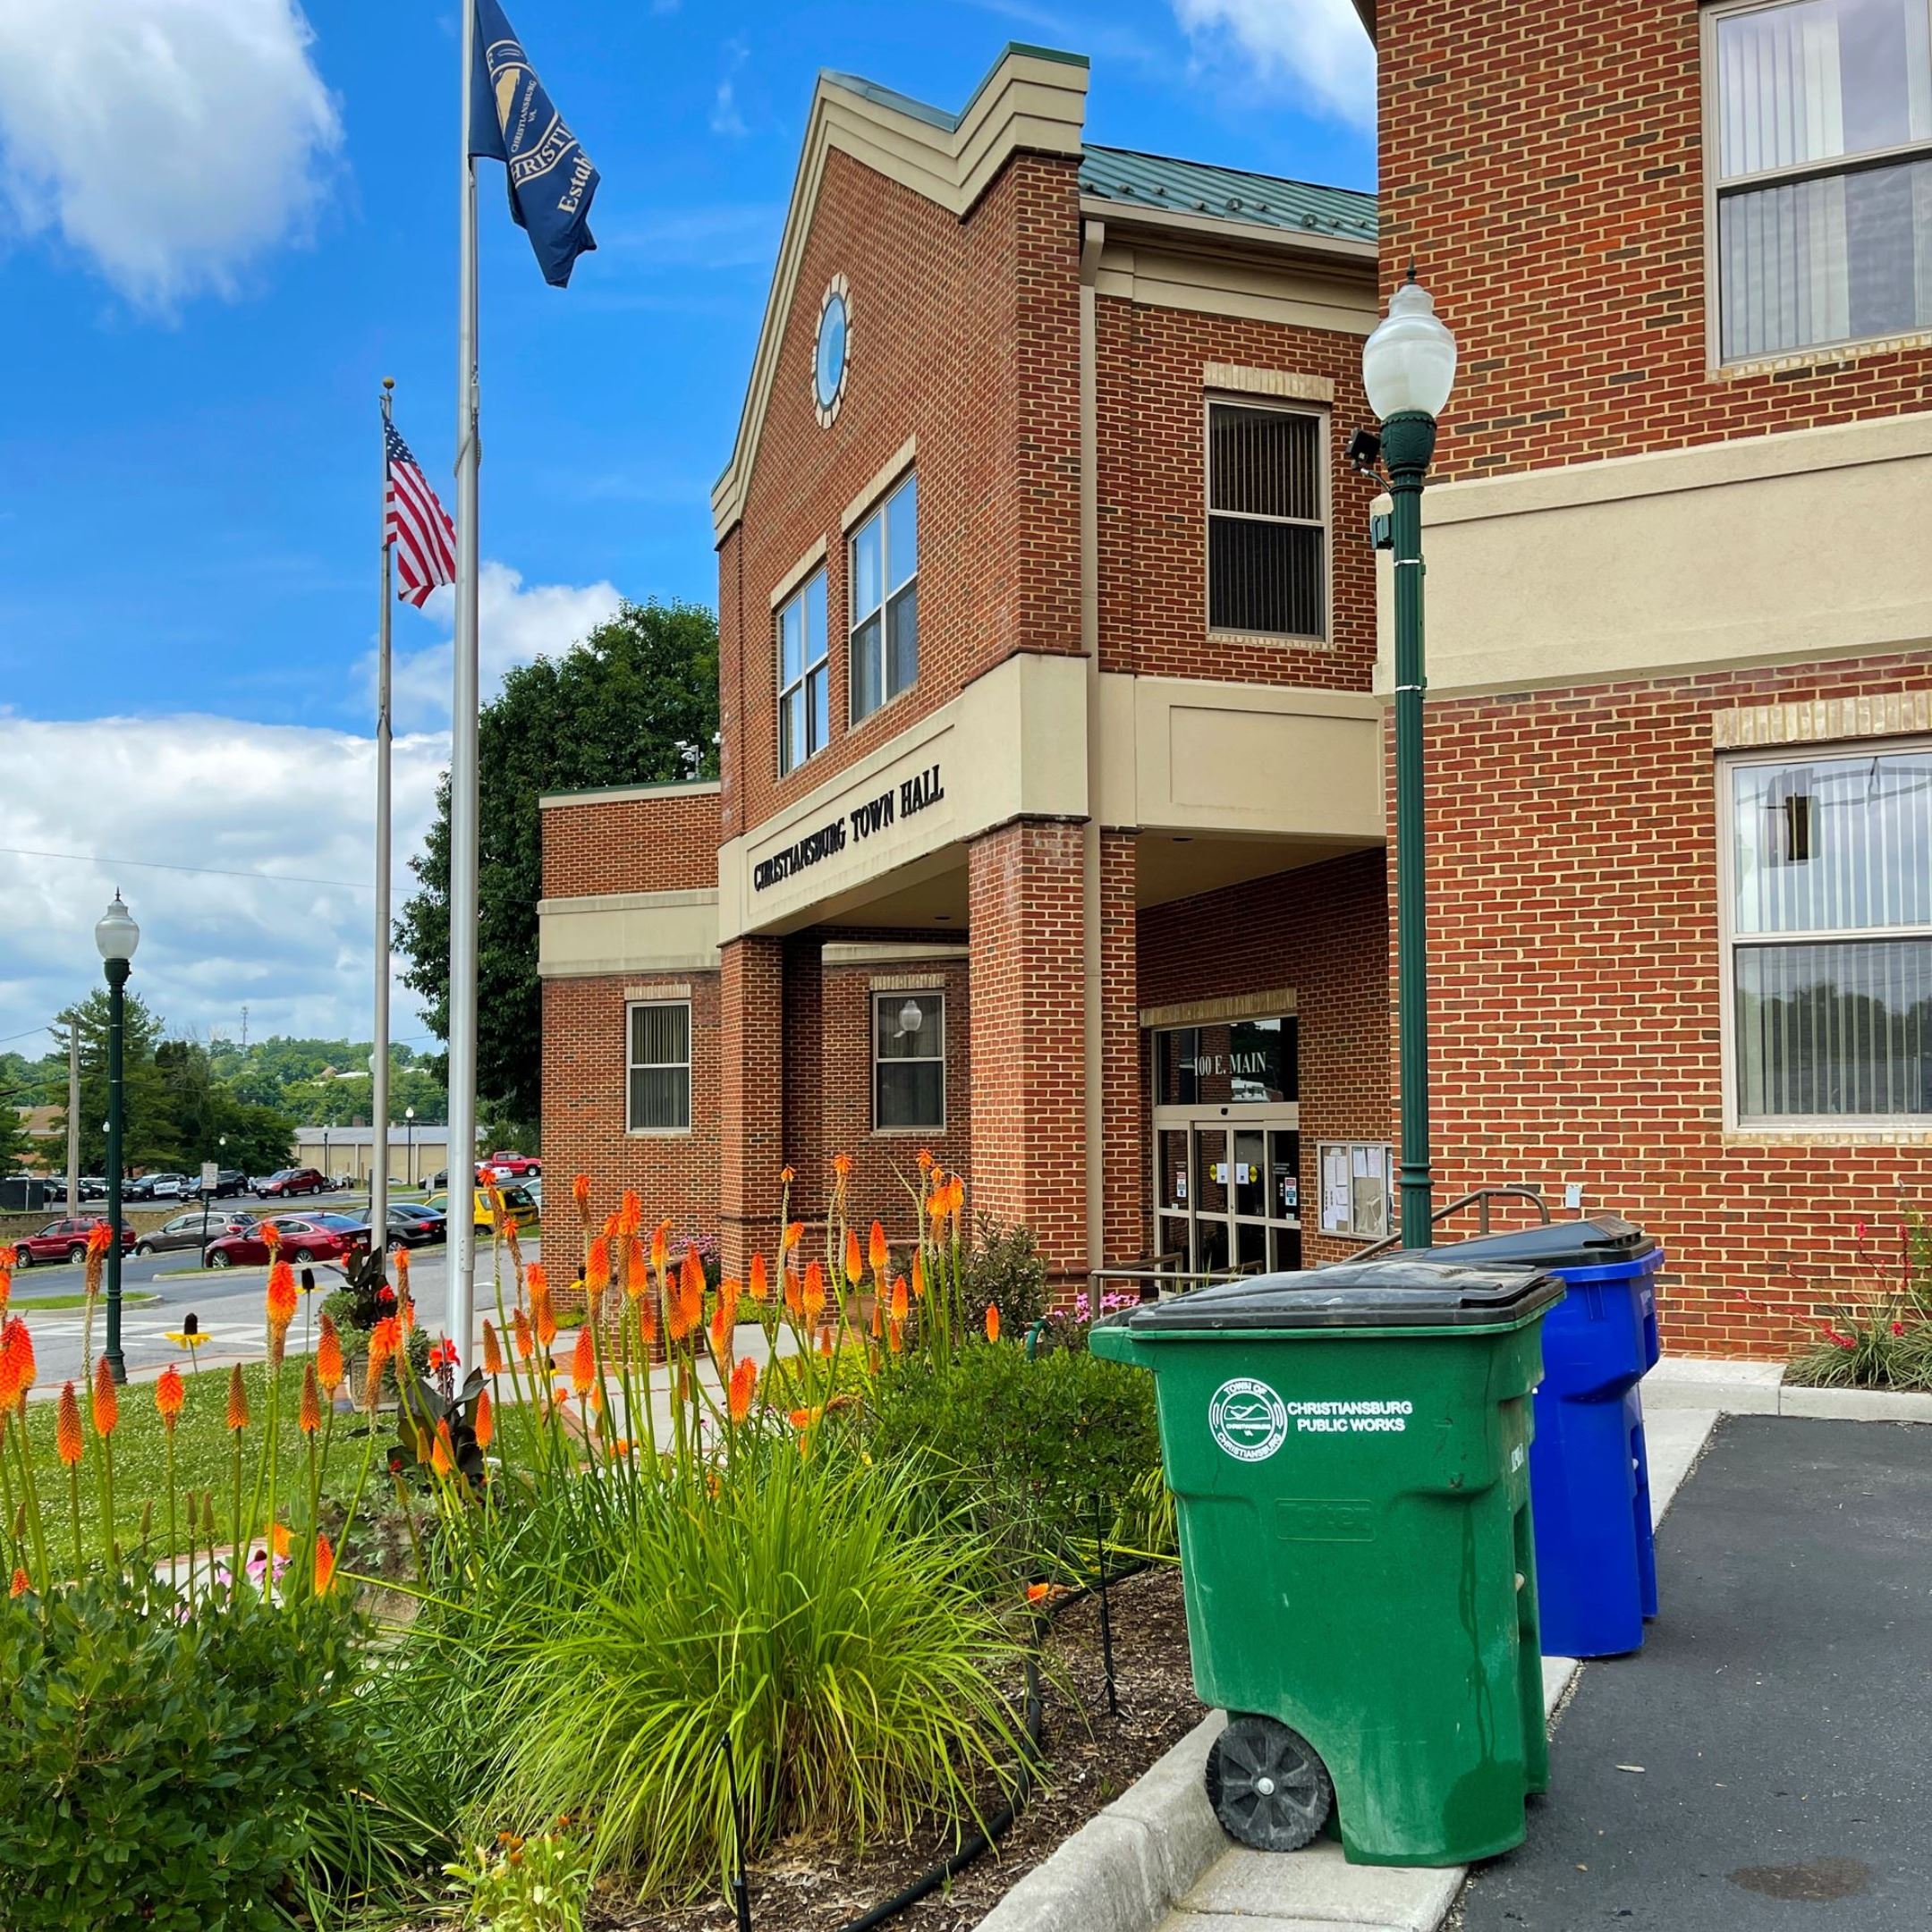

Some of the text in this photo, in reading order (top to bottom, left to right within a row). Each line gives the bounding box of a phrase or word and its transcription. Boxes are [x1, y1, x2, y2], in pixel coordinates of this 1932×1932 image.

[511, 80, 537, 153] CHRISTIANSBURG
[511, 123, 572, 182] HRISTI
[754, 764, 945, 892] CHRISTIANSBURG TOWN HALL
[1194, 1051, 1267, 1076] 100 E. MAIN
[1223, 1382, 1268, 1395] TOWN OF
[1287, 1401, 1413, 1415] CHRISTIANSBURG
[1297, 1418, 1406, 1432] PUBLIC WORKS
[1217, 1432, 1283, 1460] CHRISTIANSBURG
